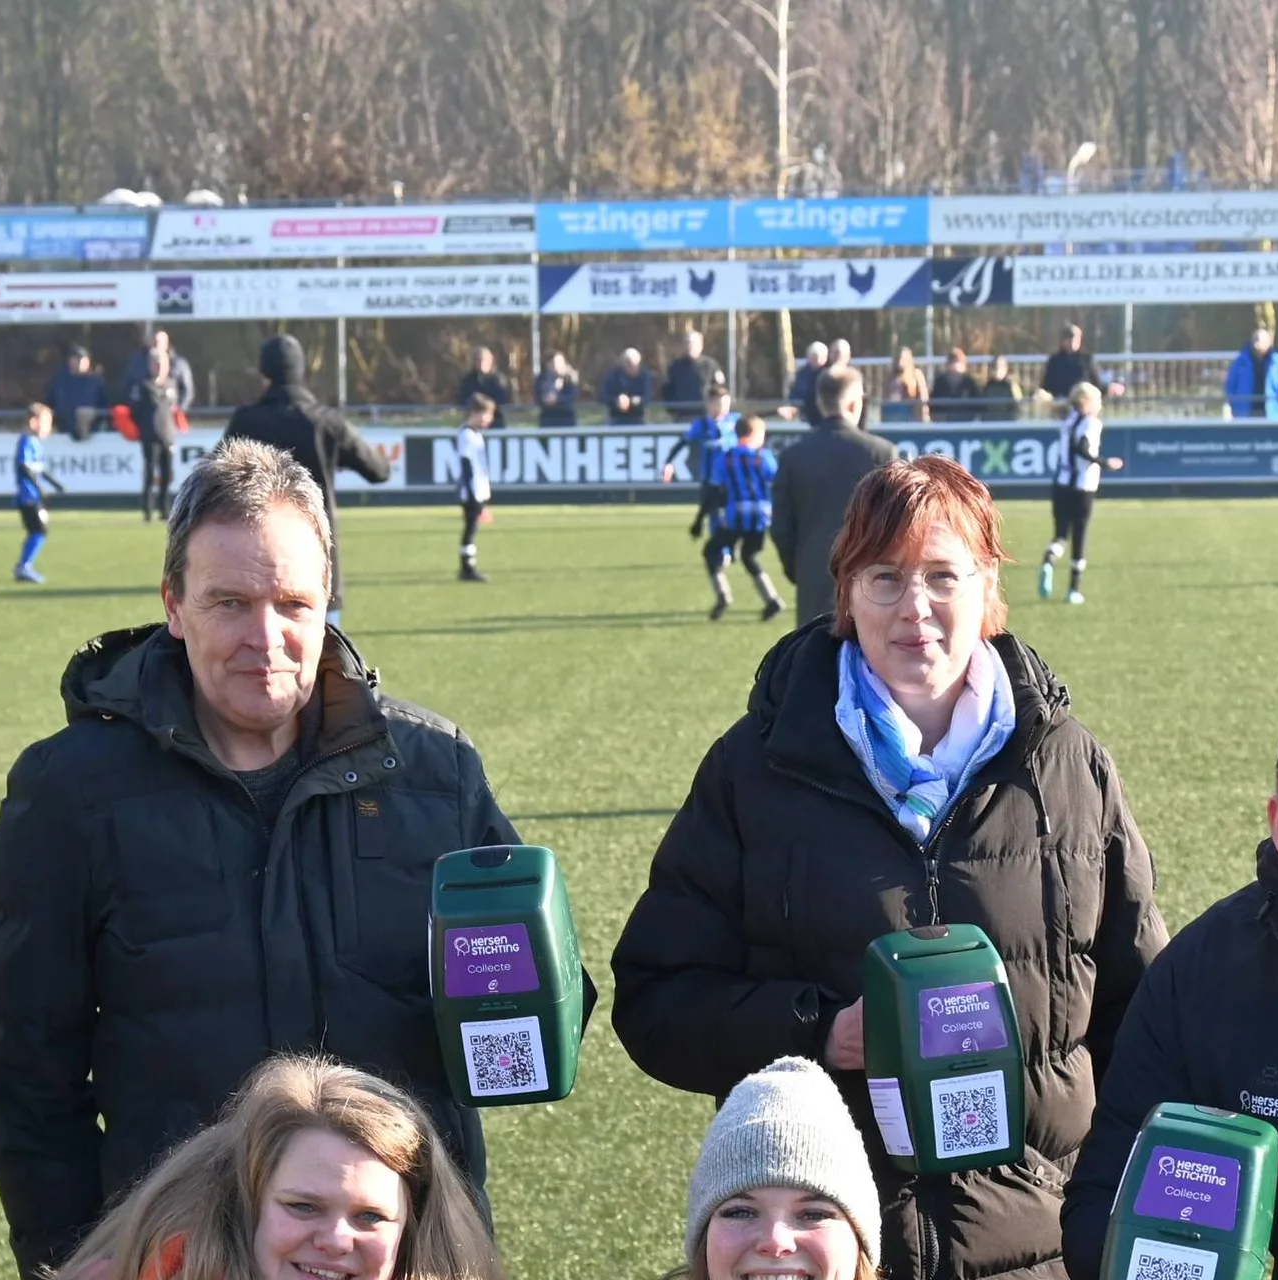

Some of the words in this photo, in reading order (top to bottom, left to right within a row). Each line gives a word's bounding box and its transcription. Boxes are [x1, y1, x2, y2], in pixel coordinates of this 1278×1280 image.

[471, 935, 508, 947] Hersen
[471, 942, 520, 956] STICHTING
[467, 961, 511, 974] Collecte
[944, 994, 979, 1006] Hersen
[944, 1001, 990, 1015] STICHTING
[942, 1020, 983, 1034] Collecte
[1175, 1159, 1217, 1176] Hersen
[1174, 1168, 1227, 1187] STICHTING
[1164, 1185, 1212, 1203] Collecte
